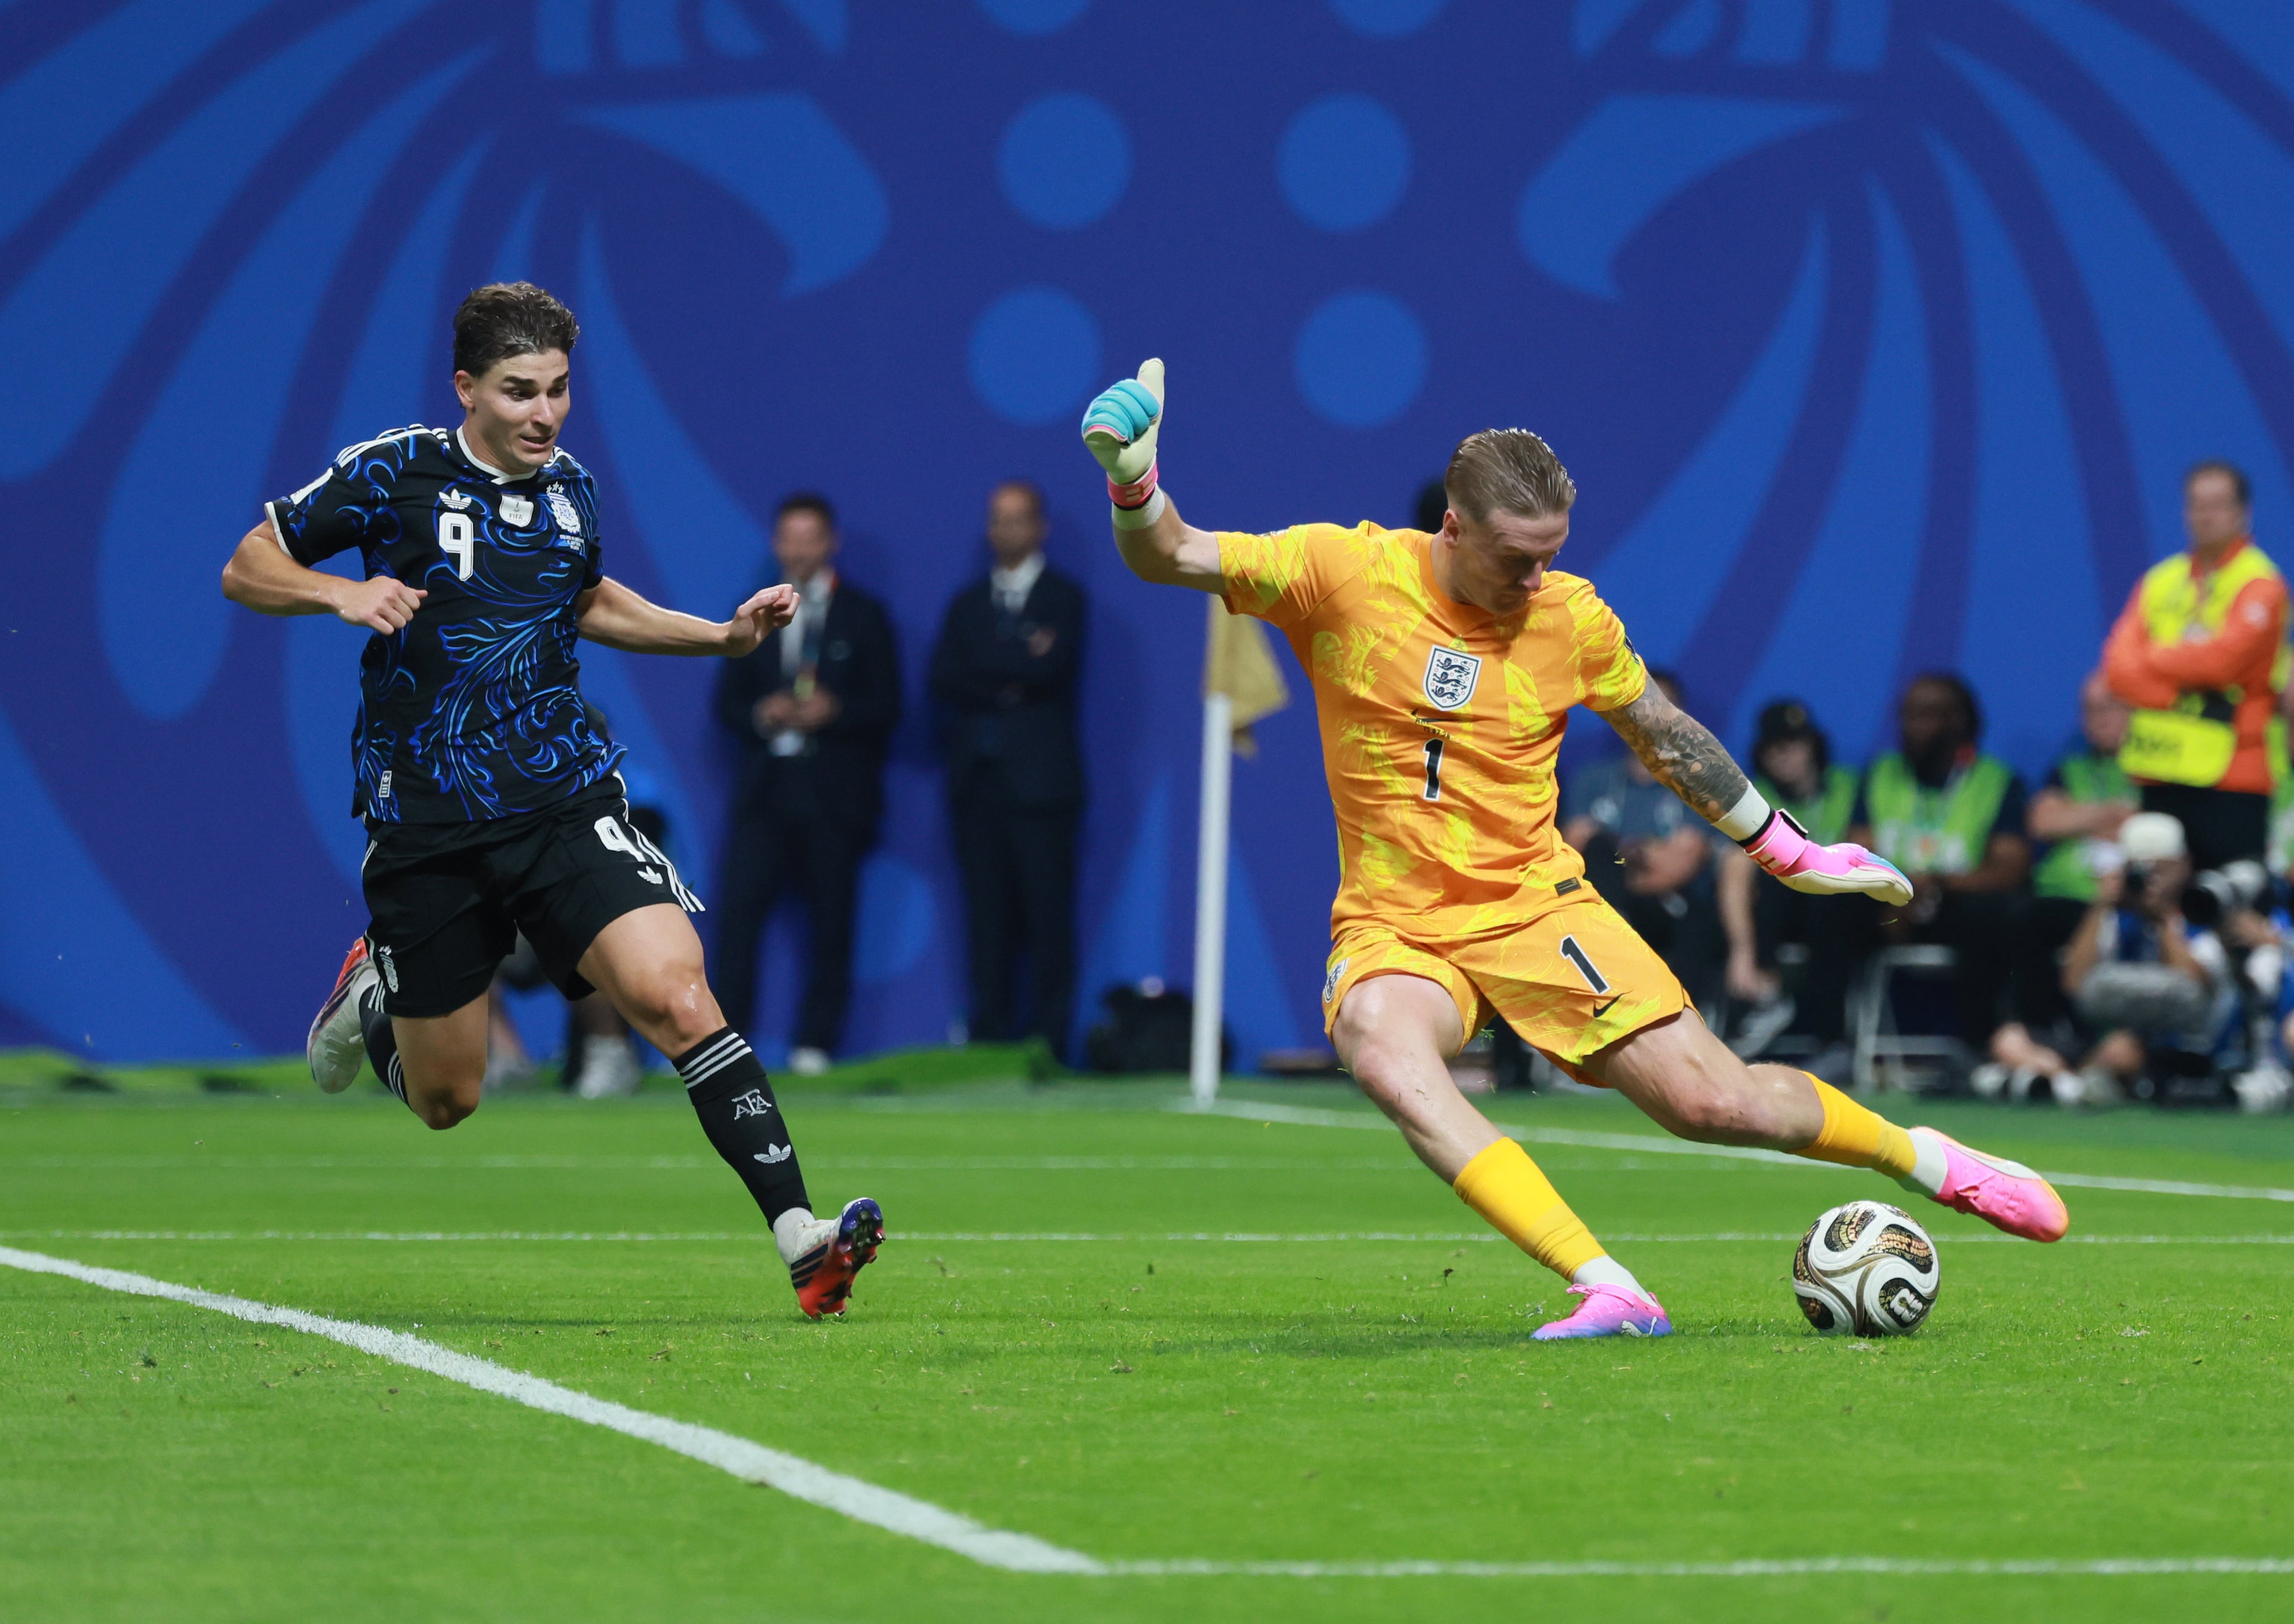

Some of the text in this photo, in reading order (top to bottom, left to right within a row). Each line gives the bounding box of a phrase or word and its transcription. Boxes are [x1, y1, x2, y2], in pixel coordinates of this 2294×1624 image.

[438, 512, 474, 582] 9
[1422, 738, 1445, 802] 1
[594, 815, 646, 862] 9
[1559, 934, 1611, 995] 1
